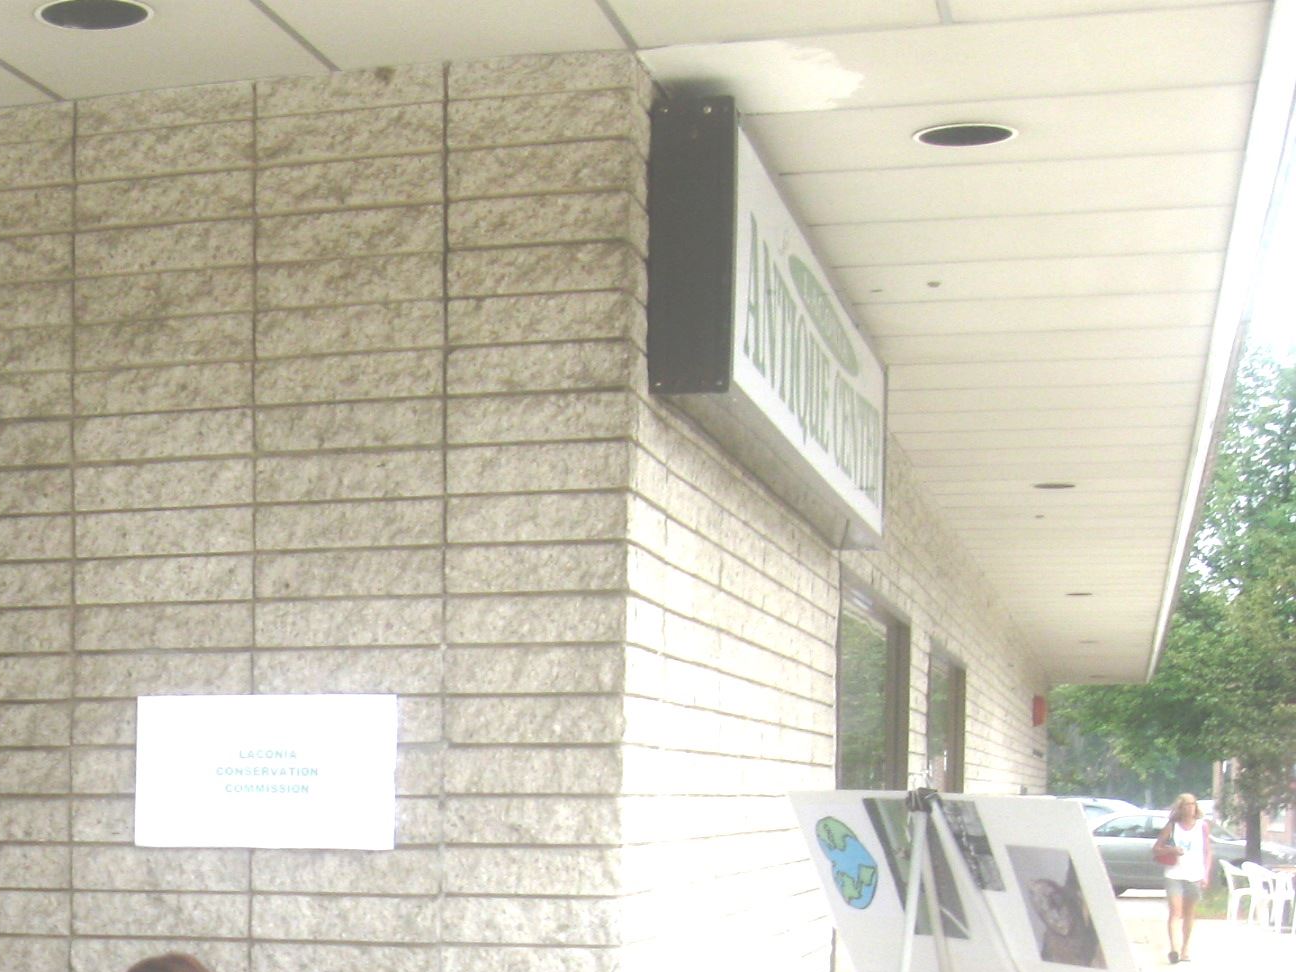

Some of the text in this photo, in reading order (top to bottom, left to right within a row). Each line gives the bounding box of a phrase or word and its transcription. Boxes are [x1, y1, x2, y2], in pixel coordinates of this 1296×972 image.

[744, 211, 829, 454] ANTIQUE
[239, 749, 297, 759] LACONIA
[215, 766, 318, 777] CONSERVATION
[224, 783, 309, 794] COMMISSION
